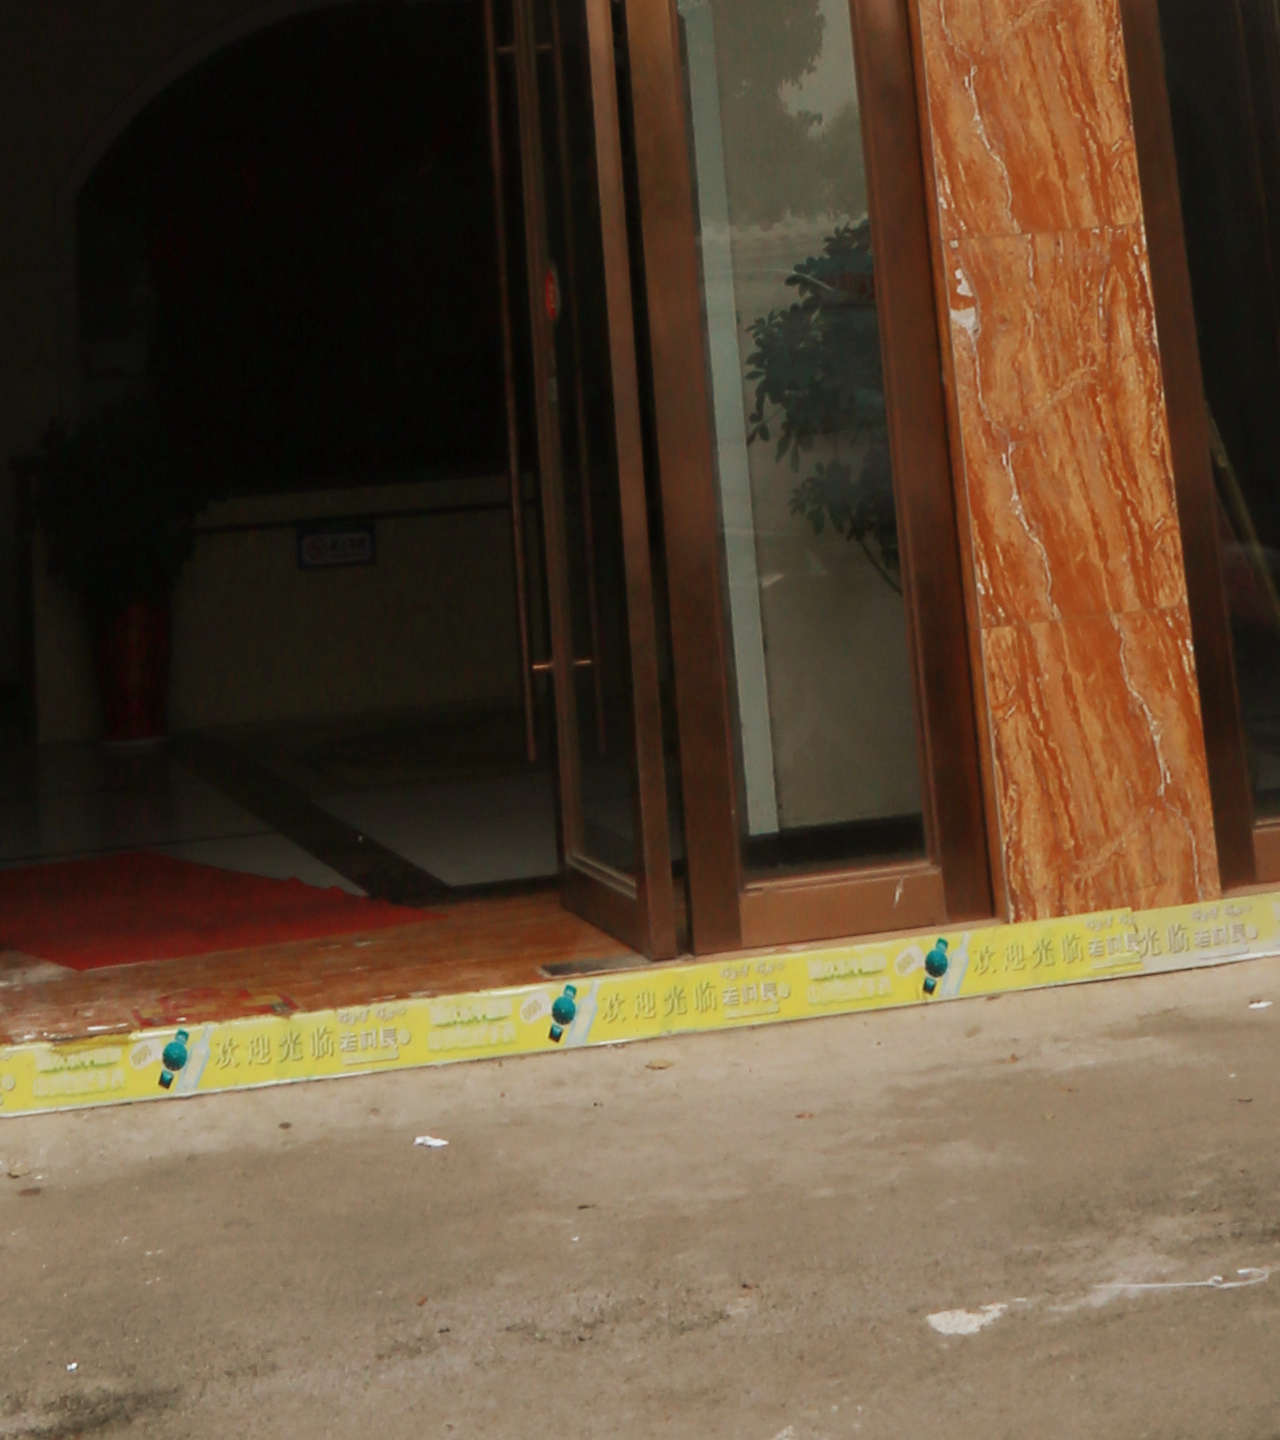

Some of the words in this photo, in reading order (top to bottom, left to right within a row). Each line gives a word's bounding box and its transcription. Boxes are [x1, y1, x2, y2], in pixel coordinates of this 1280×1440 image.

[600, 980, 718, 1024] 欢迎光临
[214, 1025, 335, 1069] 欢迎光临
